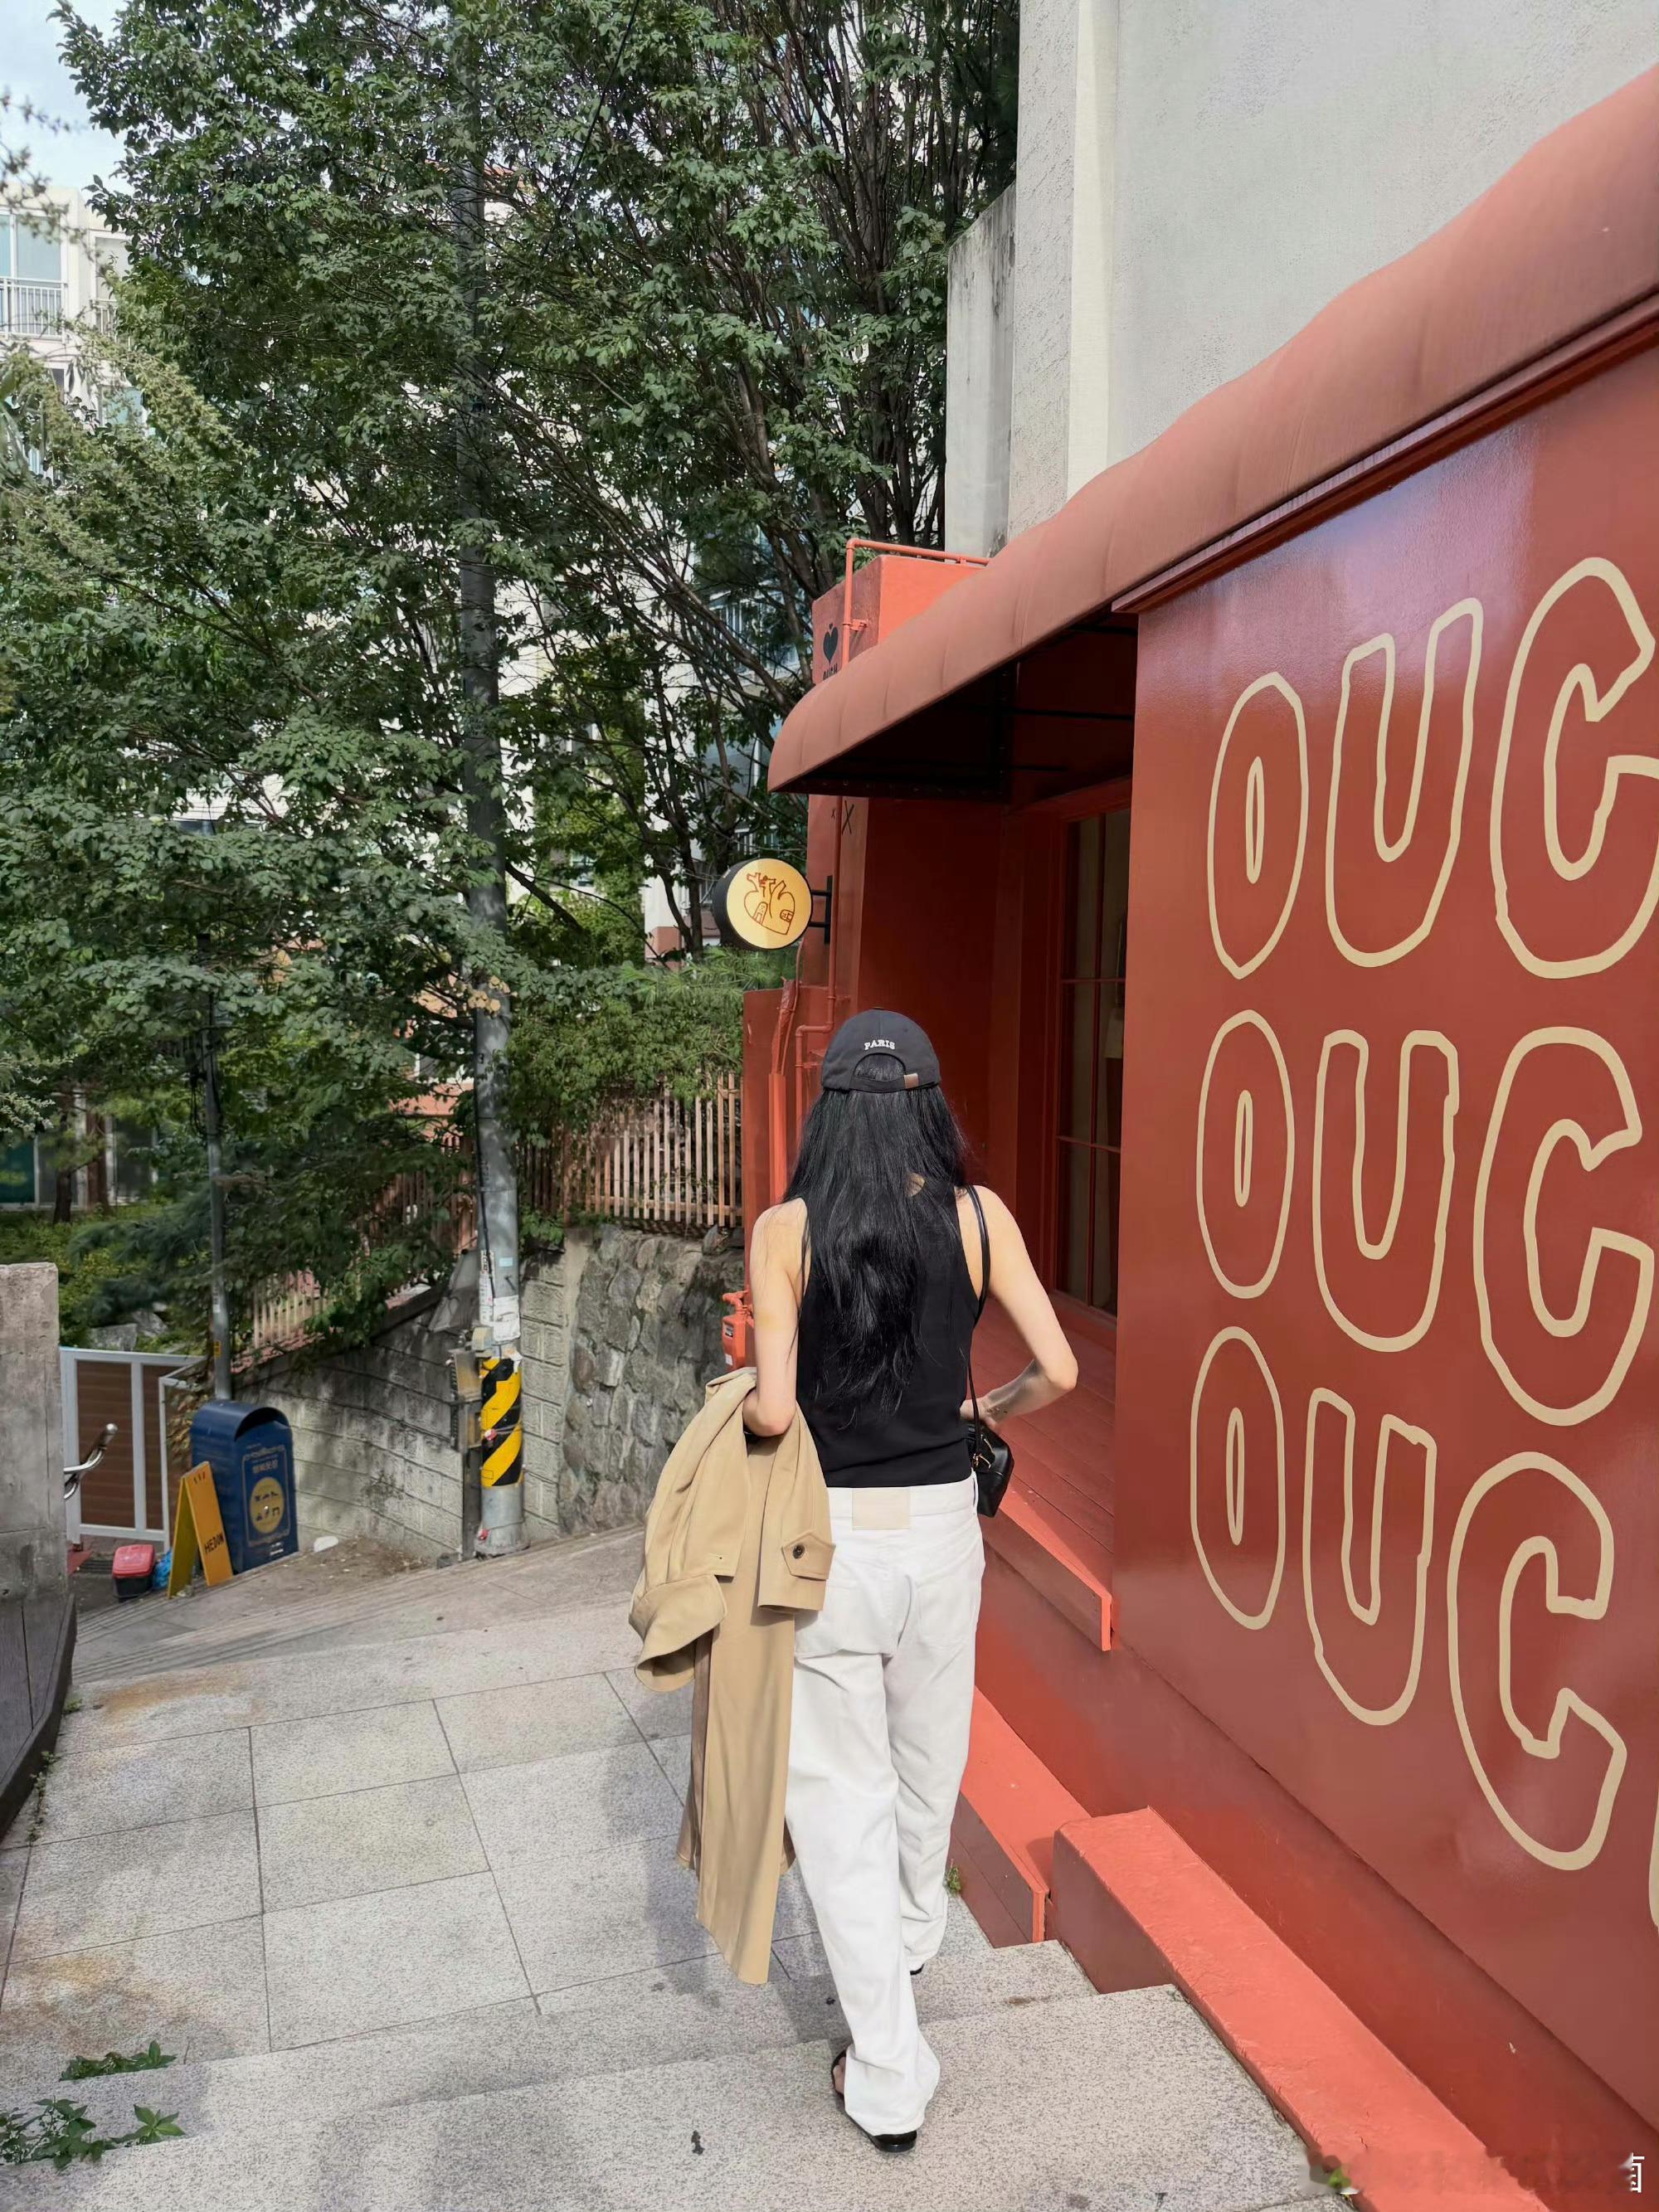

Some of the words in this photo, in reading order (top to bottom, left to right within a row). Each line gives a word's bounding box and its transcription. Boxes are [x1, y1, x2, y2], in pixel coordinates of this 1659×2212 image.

[864, 1039, 896, 1051] PARIS
[1196, 1009, 1656, 1427] OUC
[1190, 1325, 1659, 1937] OUC
